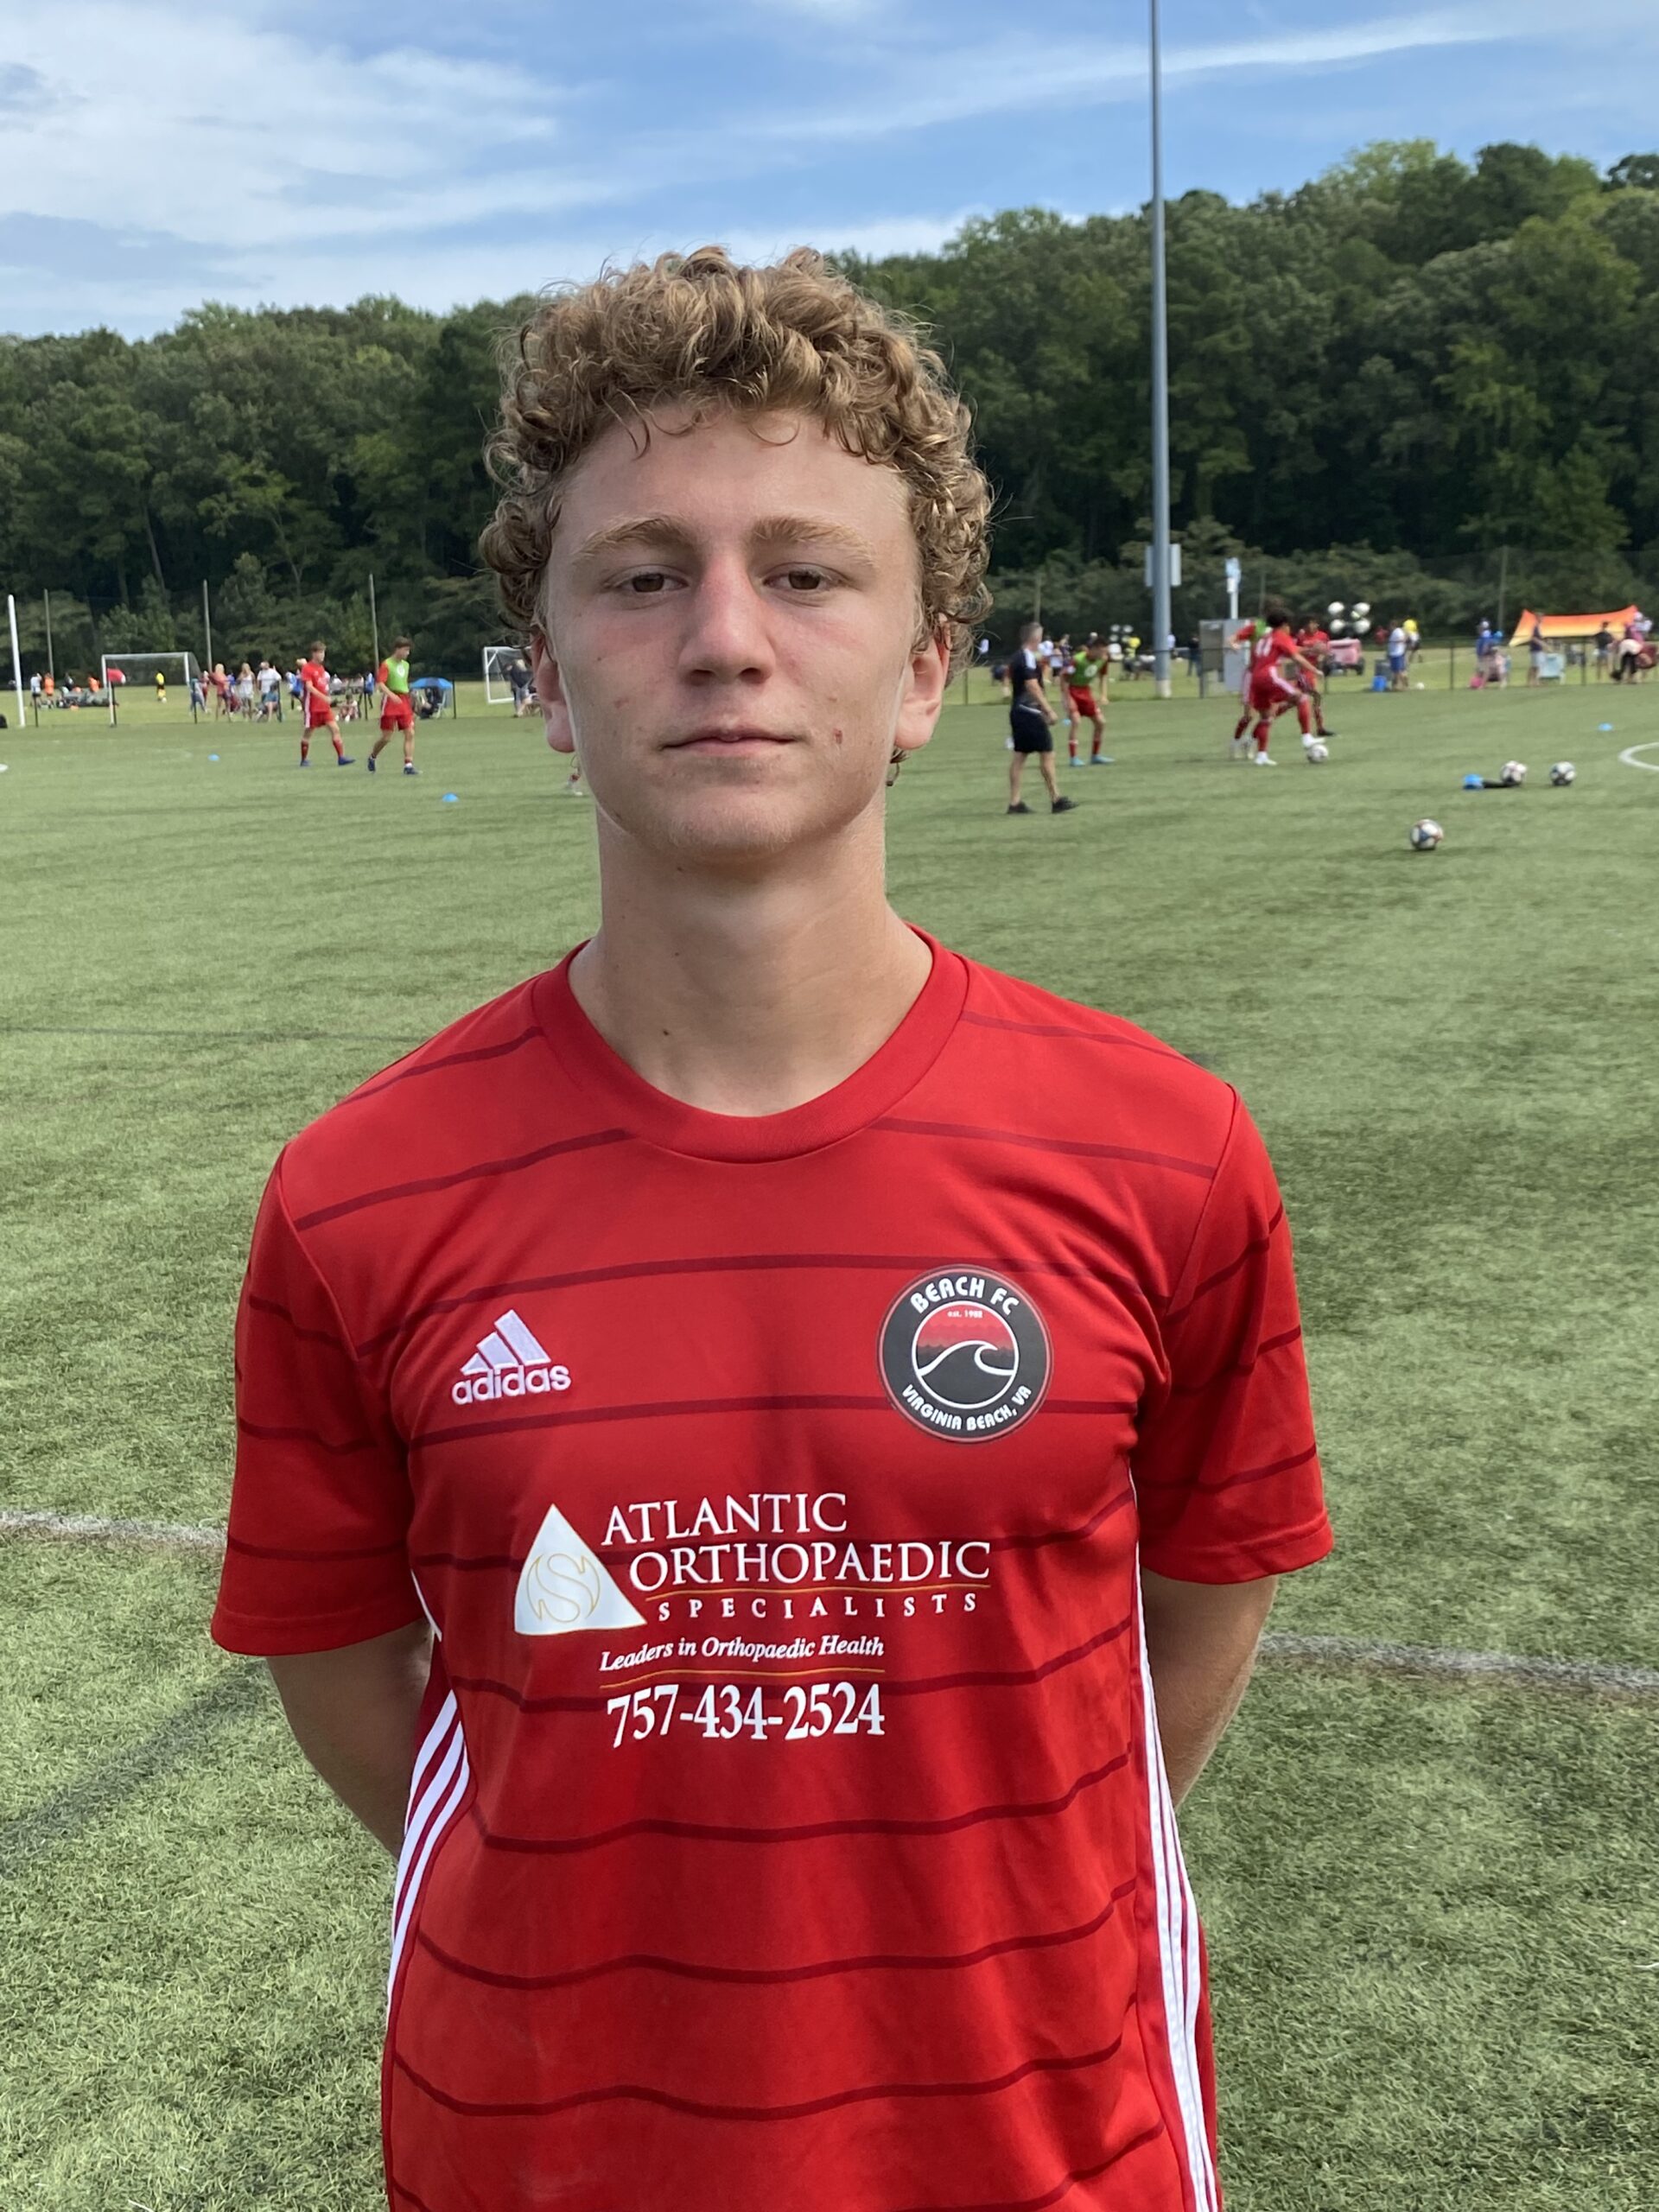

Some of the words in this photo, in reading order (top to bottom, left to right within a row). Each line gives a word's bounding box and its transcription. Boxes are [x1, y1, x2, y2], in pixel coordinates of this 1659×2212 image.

[910, 1276, 986, 1314] BEACH
[991, 1287, 1020, 1315] FC
[451, 1364, 572, 1405] adidas
[902, 1384, 963, 1430] VIRGINIA
[966, 1408, 1018, 1431] BEACH,
[1011, 1385, 1033, 1406] VA
[601, 1492, 847, 1545] ATLANTIC
[629, 1541, 991, 1592] ORTHOPAEDIC
[658, 1592, 976, 1622] SPECIALISTS
[599, 1643, 674, 1672] Leaders
[677, 1637, 697, 1657] in
[701, 1636, 816, 1662] Orthopaedic
[817, 1635, 885, 1657] Health
[607, 1681, 886, 1749] 757-434-2524
